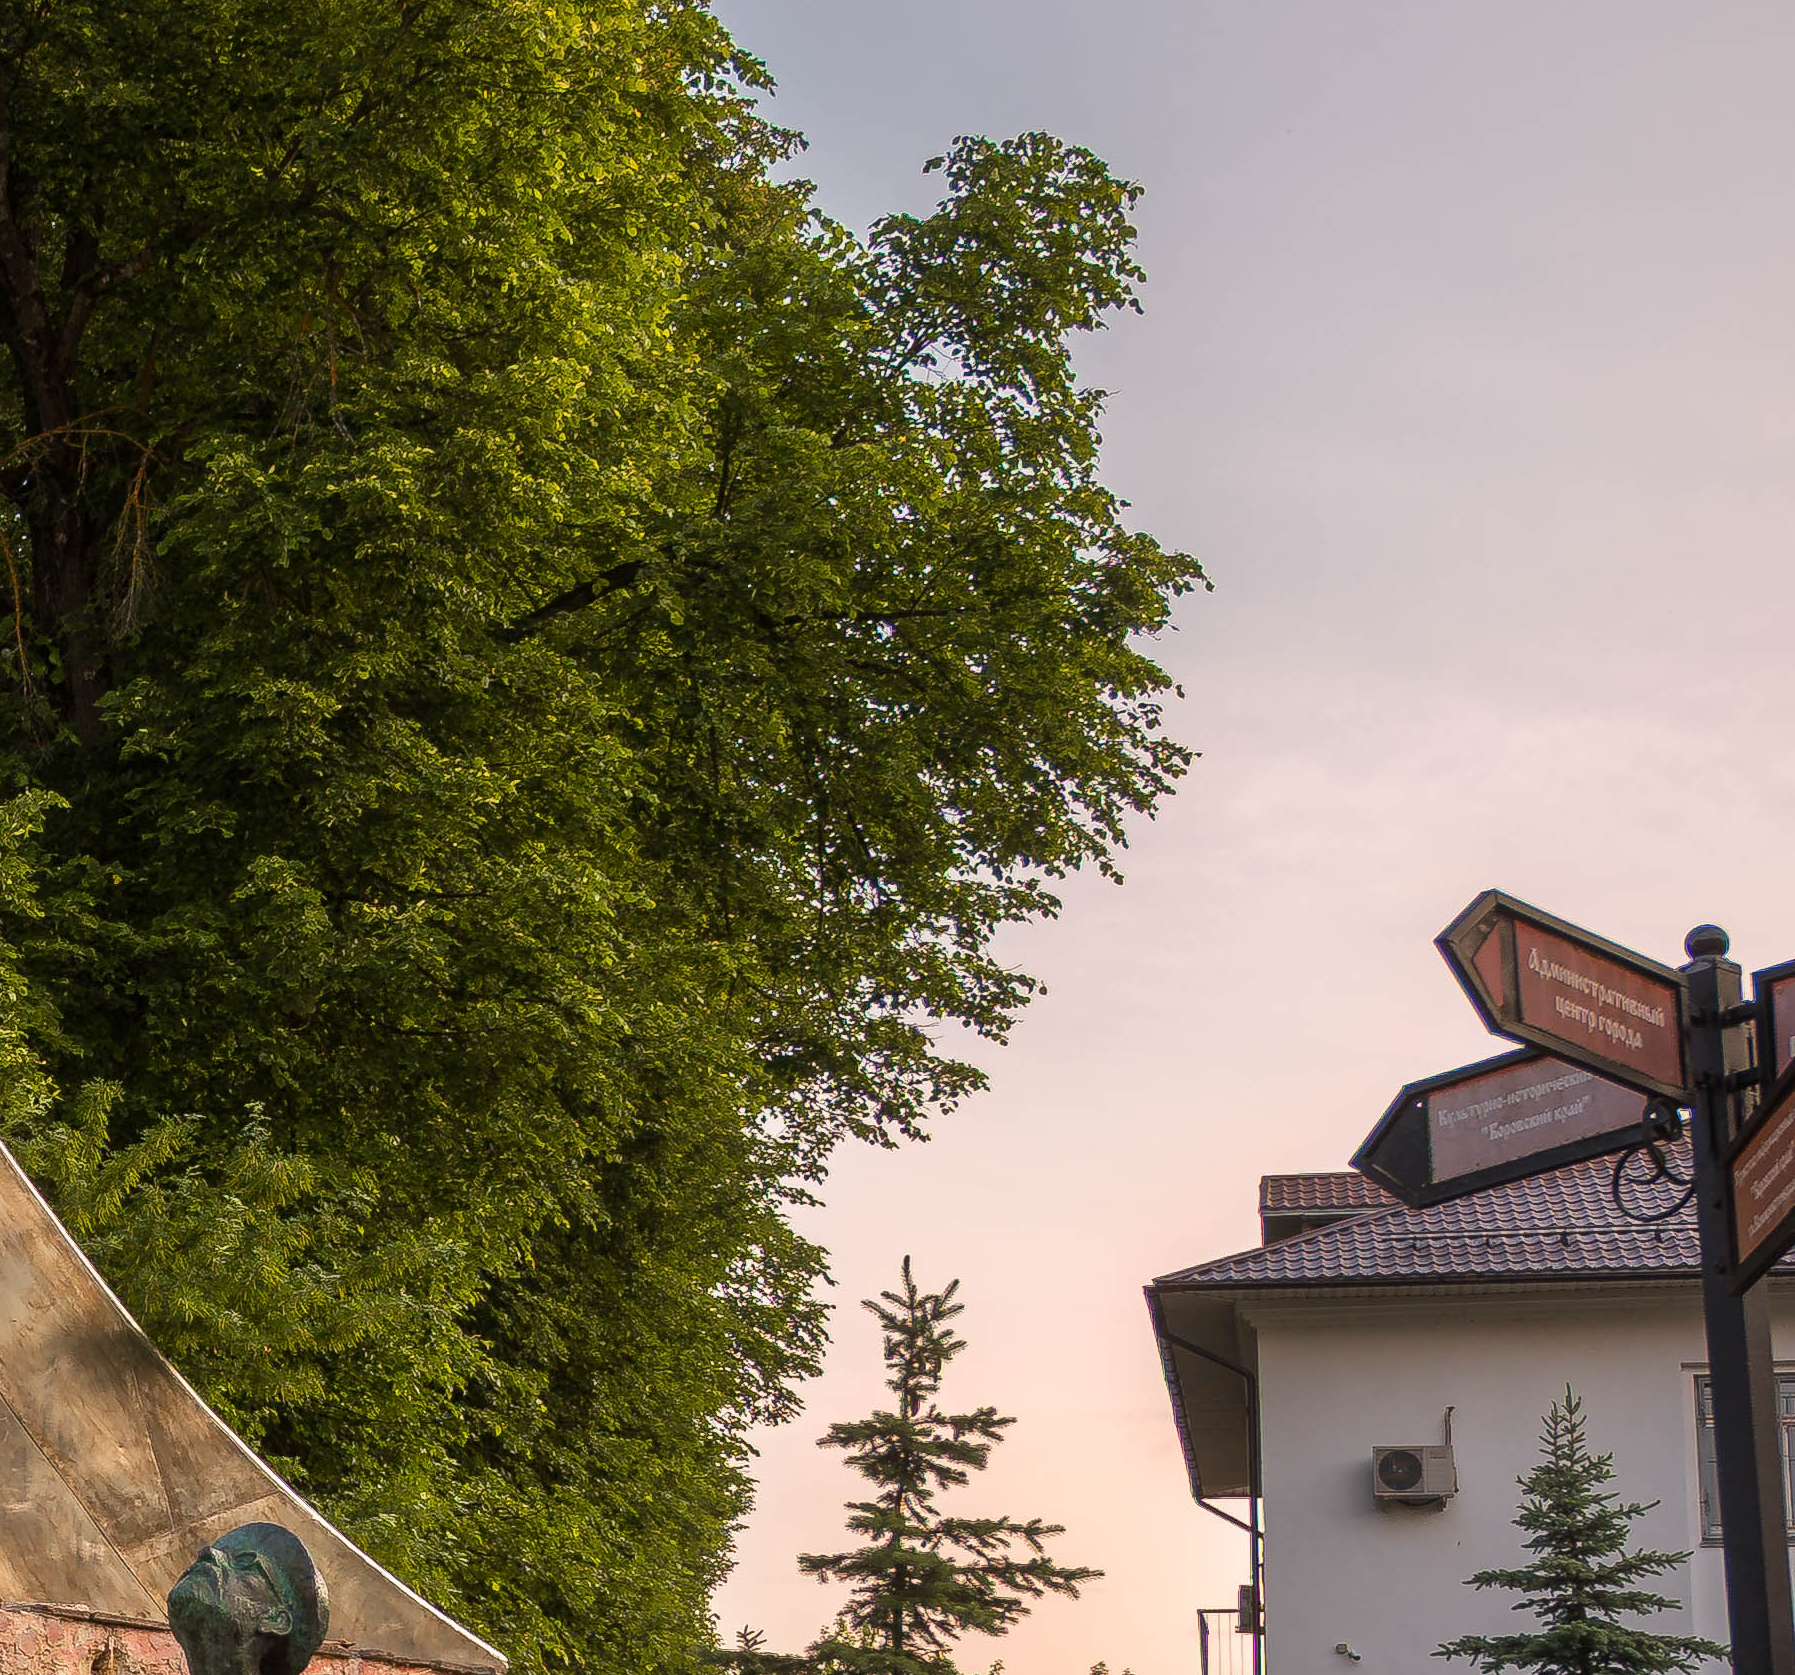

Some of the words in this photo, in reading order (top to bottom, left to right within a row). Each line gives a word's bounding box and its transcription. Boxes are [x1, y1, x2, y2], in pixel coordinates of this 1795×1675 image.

[1528, 947, 1665, 1027] Административный
[1555, 995, 1596, 1034] центр
[1598, 1015, 1644, 1051] города
